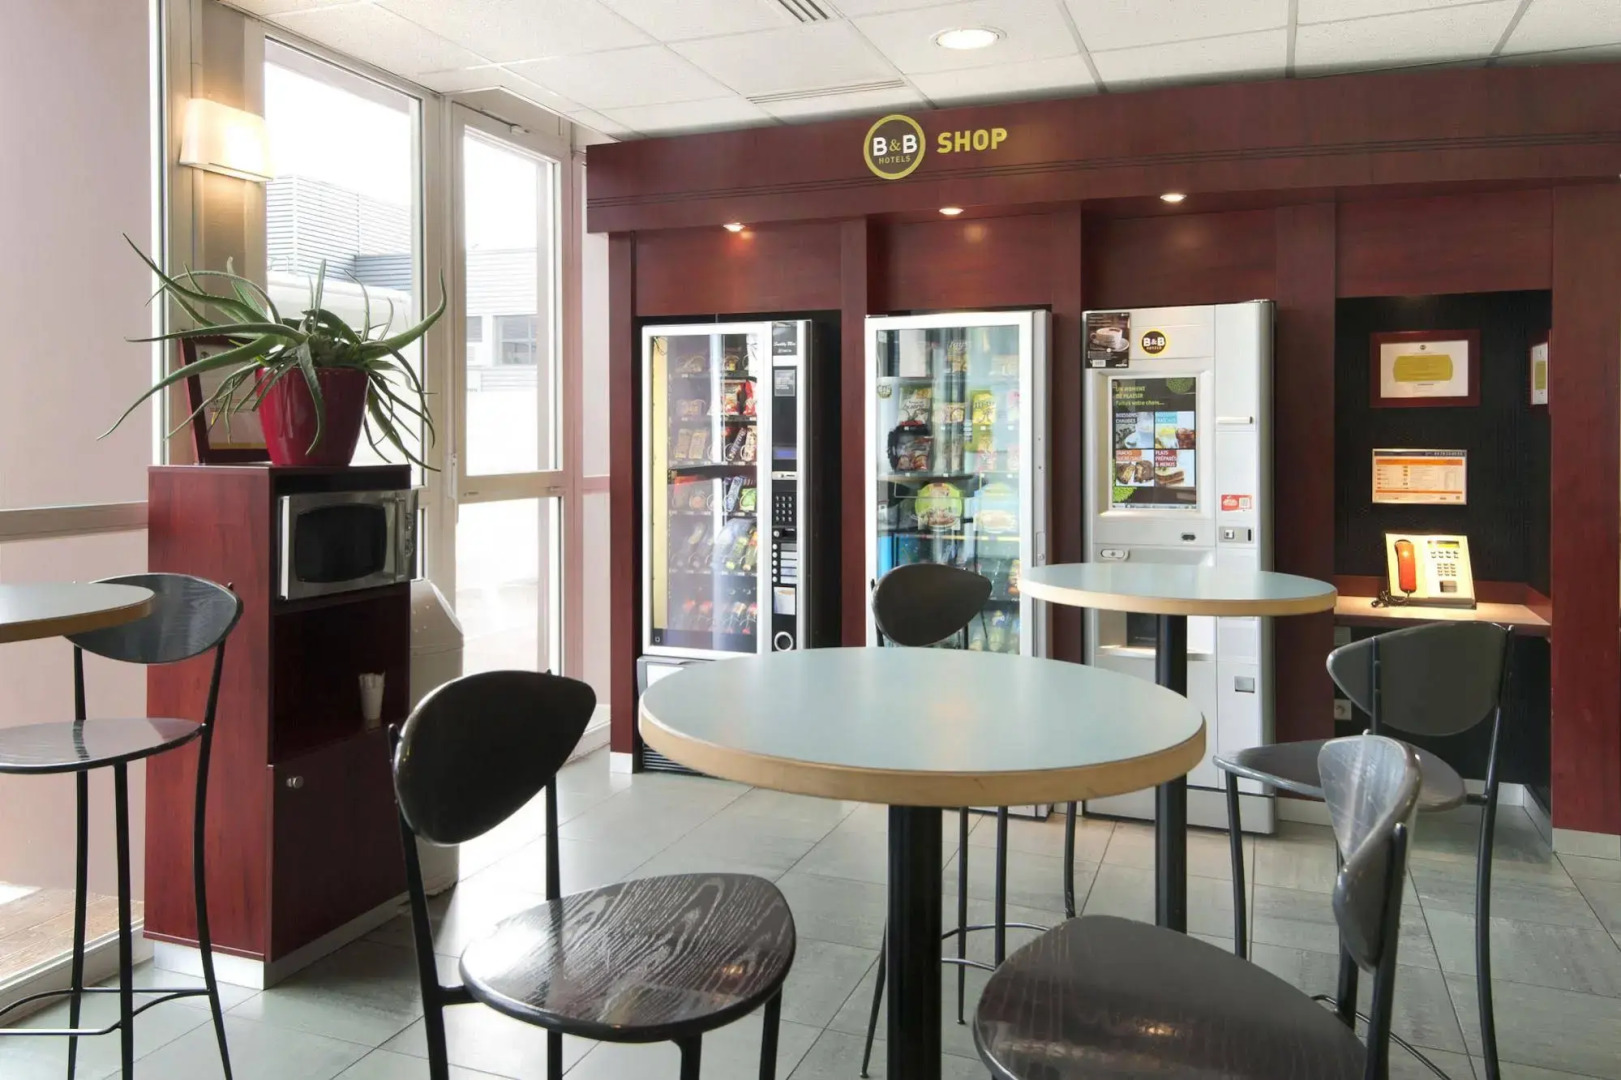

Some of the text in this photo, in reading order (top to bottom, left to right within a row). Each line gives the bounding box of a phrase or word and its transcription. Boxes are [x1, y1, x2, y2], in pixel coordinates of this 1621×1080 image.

[872, 134, 918, 157] B&B
[936, 127, 1008, 154] SHOP
[878, 154, 911, 165] HOTELS
[1143, 336, 1166, 347] B&B
